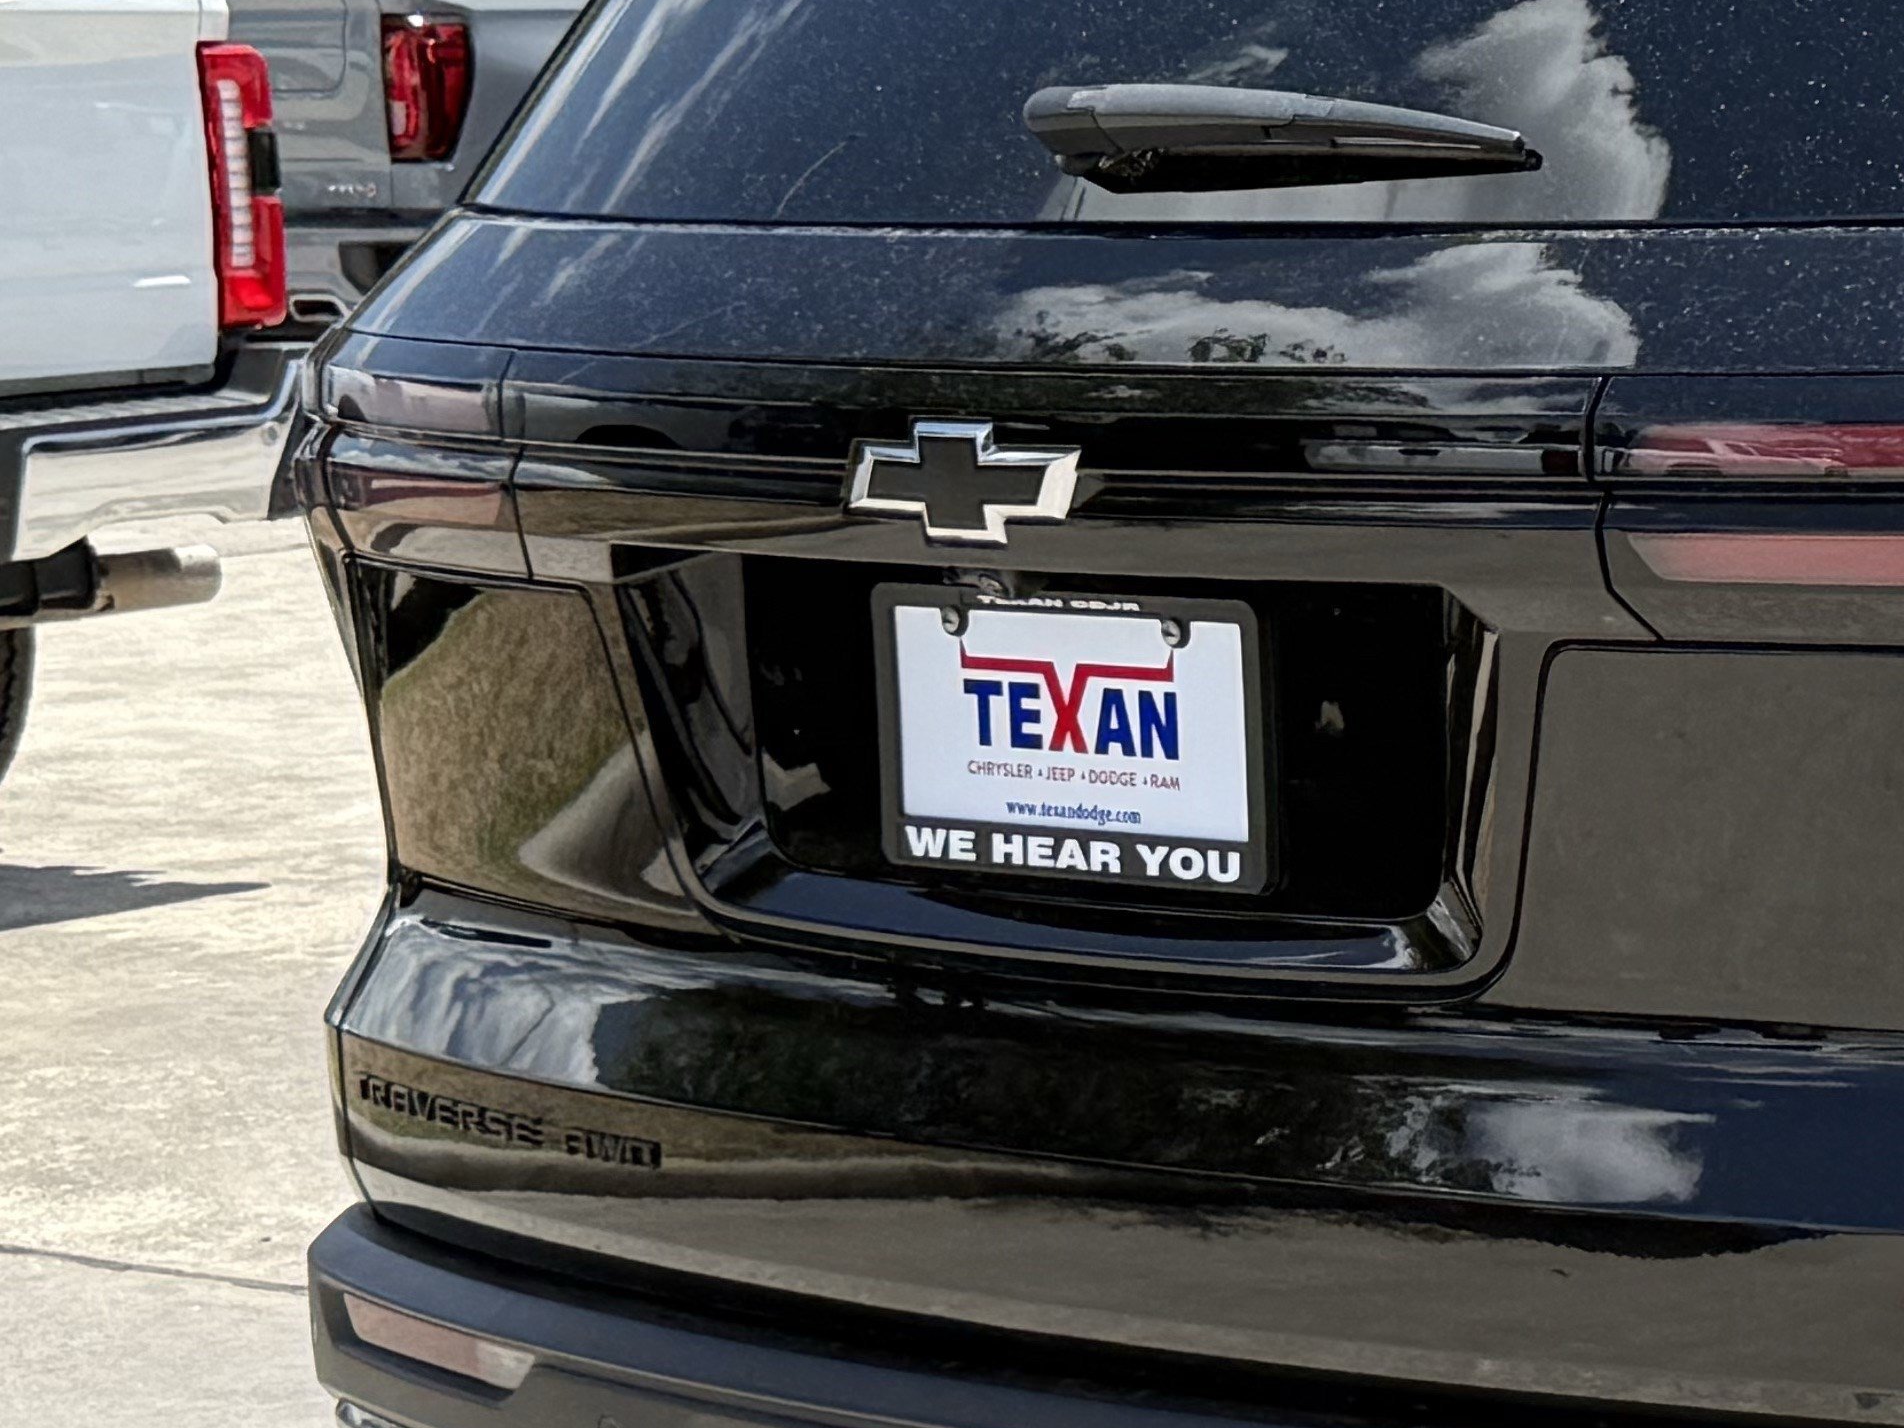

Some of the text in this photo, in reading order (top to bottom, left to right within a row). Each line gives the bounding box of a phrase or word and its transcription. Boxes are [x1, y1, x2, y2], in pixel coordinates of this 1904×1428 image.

[962, 662, 1180, 761] TEXAN
[967, 759, 1181, 791] CHRYSLER JEEP DODGE RAM
[1005, 801, 1142, 826] www.texandodge.com
[905, 825, 1241, 884] WE HEAR YOU
